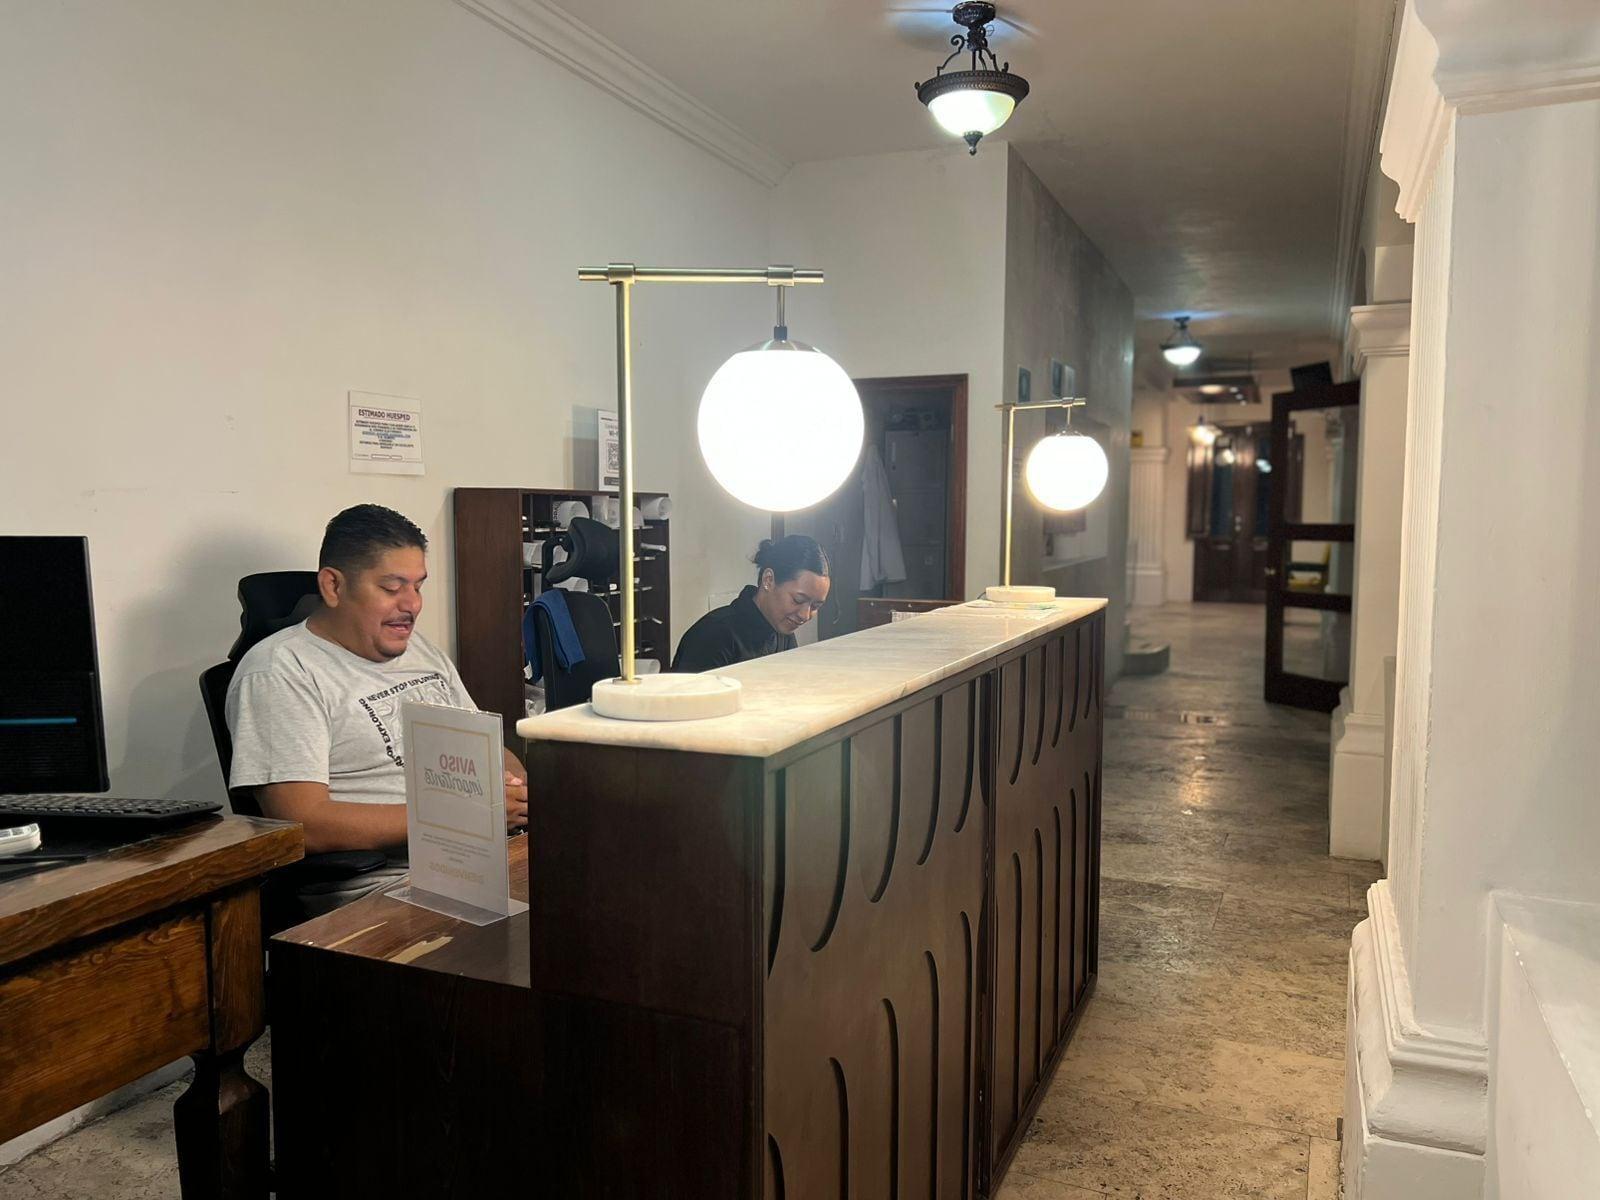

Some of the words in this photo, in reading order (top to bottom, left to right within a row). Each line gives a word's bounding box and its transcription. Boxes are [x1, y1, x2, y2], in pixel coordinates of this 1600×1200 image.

[358, 408, 385, 418] ESTIMADO
[366, 690, 391, 701] NEVER
[389, 682, 408, 695] STOP
[358, 698, 391, 743] EXPLORING
